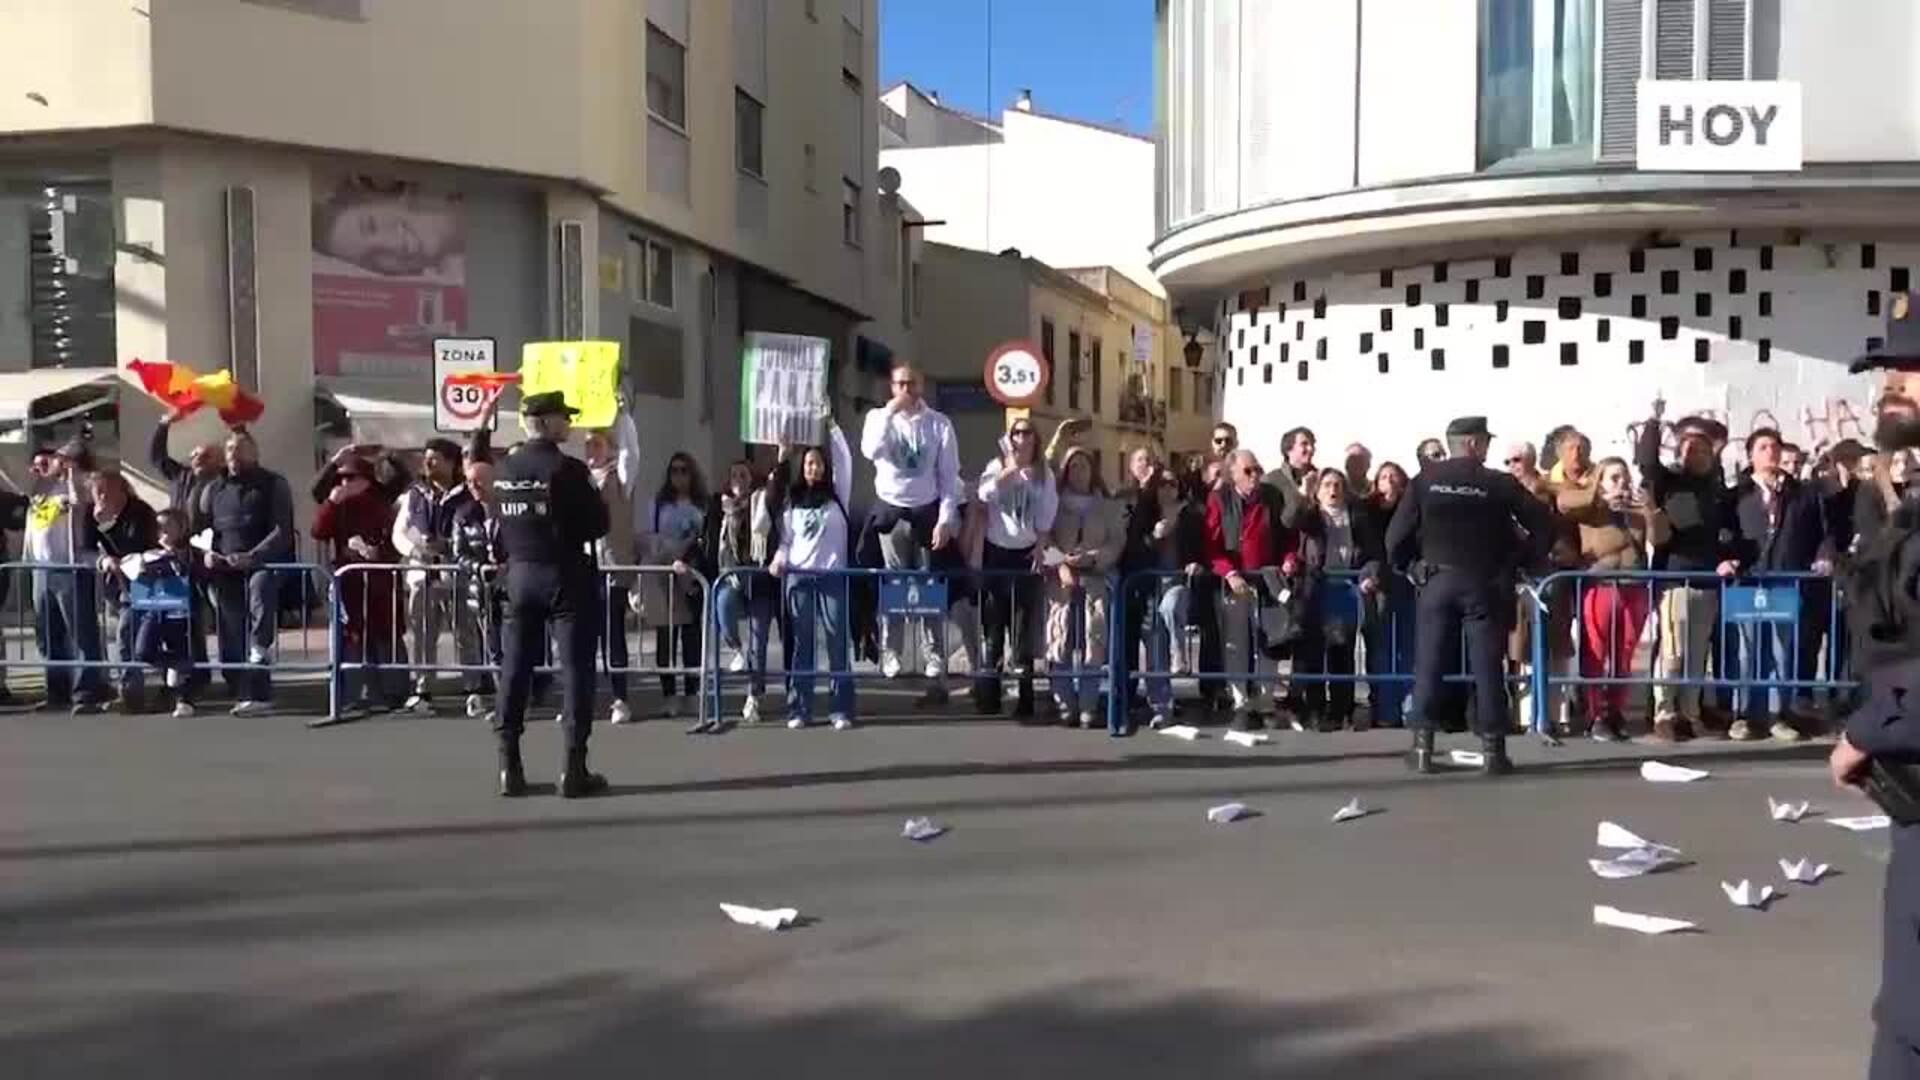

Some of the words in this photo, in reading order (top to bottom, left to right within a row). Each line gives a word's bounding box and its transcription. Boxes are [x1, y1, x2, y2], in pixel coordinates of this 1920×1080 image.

[441, 350, 487, 361] ZONA
[452, 387, 480, 403] 30
[501, 503, 528, 516] UIP
